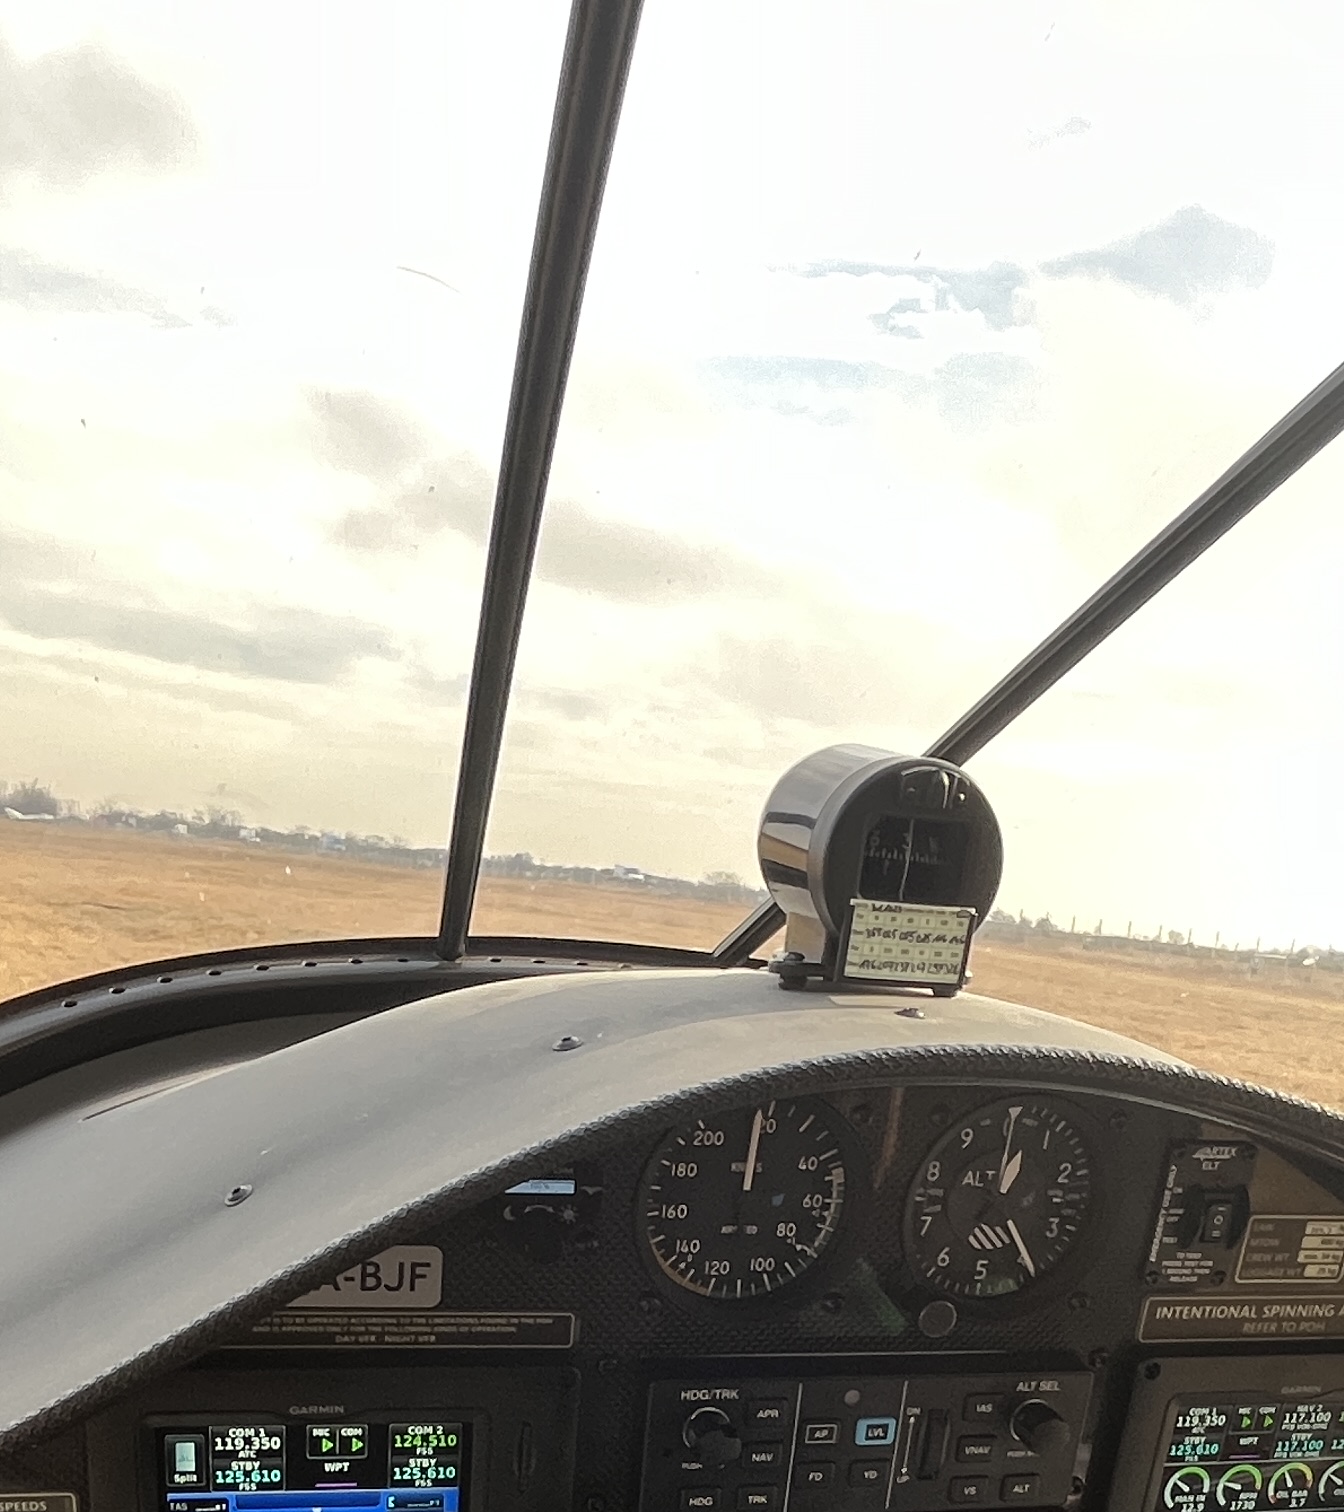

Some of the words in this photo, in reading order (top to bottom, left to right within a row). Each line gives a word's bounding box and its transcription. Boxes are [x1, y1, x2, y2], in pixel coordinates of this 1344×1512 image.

[693, 1131, 725, 1146] 200
[960, 1128, 974, 1149] 9
[798, 1156, 818, 1171] 40
[671, 1163, 698, 1177] 180
[927, 1161, 941, 1181] 8
[1057, 1163, 1072, 1183] 2
[962, 1171, 996, 1187] ALT
[802, 1193, 823, 1208] 60
[661, 1205, 688, 1219] 160
[776, 1223, 797, 1237] 80
[920, 1216, 933, 1236] 7
[1045, 1217, 1060, 1238] 3
[676, 1239, 701, 1254] 140
[937, 1247, 950, 1267] 6
[705, 1260, 730, 1275] 120
[750, 1257, 776, 1272] 100
[974, 1260, 989, 1279] 5
[1156, 1306, 1257, 1319] INTENTIONAL
[1262, 1305, 1335, 1318] SPINNING
[1243, 1322, 1278, 1333] REFER
[1281, 1322, 1296, 1333] TO
[1016, 1382, 1036, 1392] ALT
[1039, 1381, 1061, 1391] SEL
[681, 1389, 739, 1401] HDG/TRK
[289, 1405, 344, 1416] GARMIN
[757, 1409, 779, 1418] APR
[1177, 1415, 1227, 1428] 119.350
[1283, 1412, 1332, 1424] 117.100
[228, 1427, 257, 1438] COM
[259, 1427, 266, 1437] 1
[312, 1427, 331, 1437] MIC
[341, 1427, 362, 1437] COM
[407, 1425, 434, 1436] COM
[436, 1425, 444, 1435] 2
[814, 1430, 829, 1438] AP
[867, 1428, 885, 1437] LVL
[214, 1437, 281, 1451] 119.350
[393, 1434, 457, 1448] 124.510
[1275, 1440, 1324, 1452] 117.100
[238, 1450, 256, 1459] ATC
[752, 1452, 774, 1462] NAV
[231, 1460, 260, 1471] STBY
[324, 1462, 350, 1473] WPT
[408, 1457, 437, 1468] STBY
[174, 1473, 198, 1485] Split
[215, 1470, 281, 1483] 125.610
[393, 1467, 456, 1480] 125.610
[808, 1472, 823, 1481] FD
[964, 1487, 977, 1496] VS
[1013, 1484, 1031, 1493] ALT
[689, 1497, 713, 1506] HDG
[748, 1495, 768, 1504] TRK
[1230, 1500, 1256, 1511] 1730
[1181, 1502, 1206, 1512] 12.9
